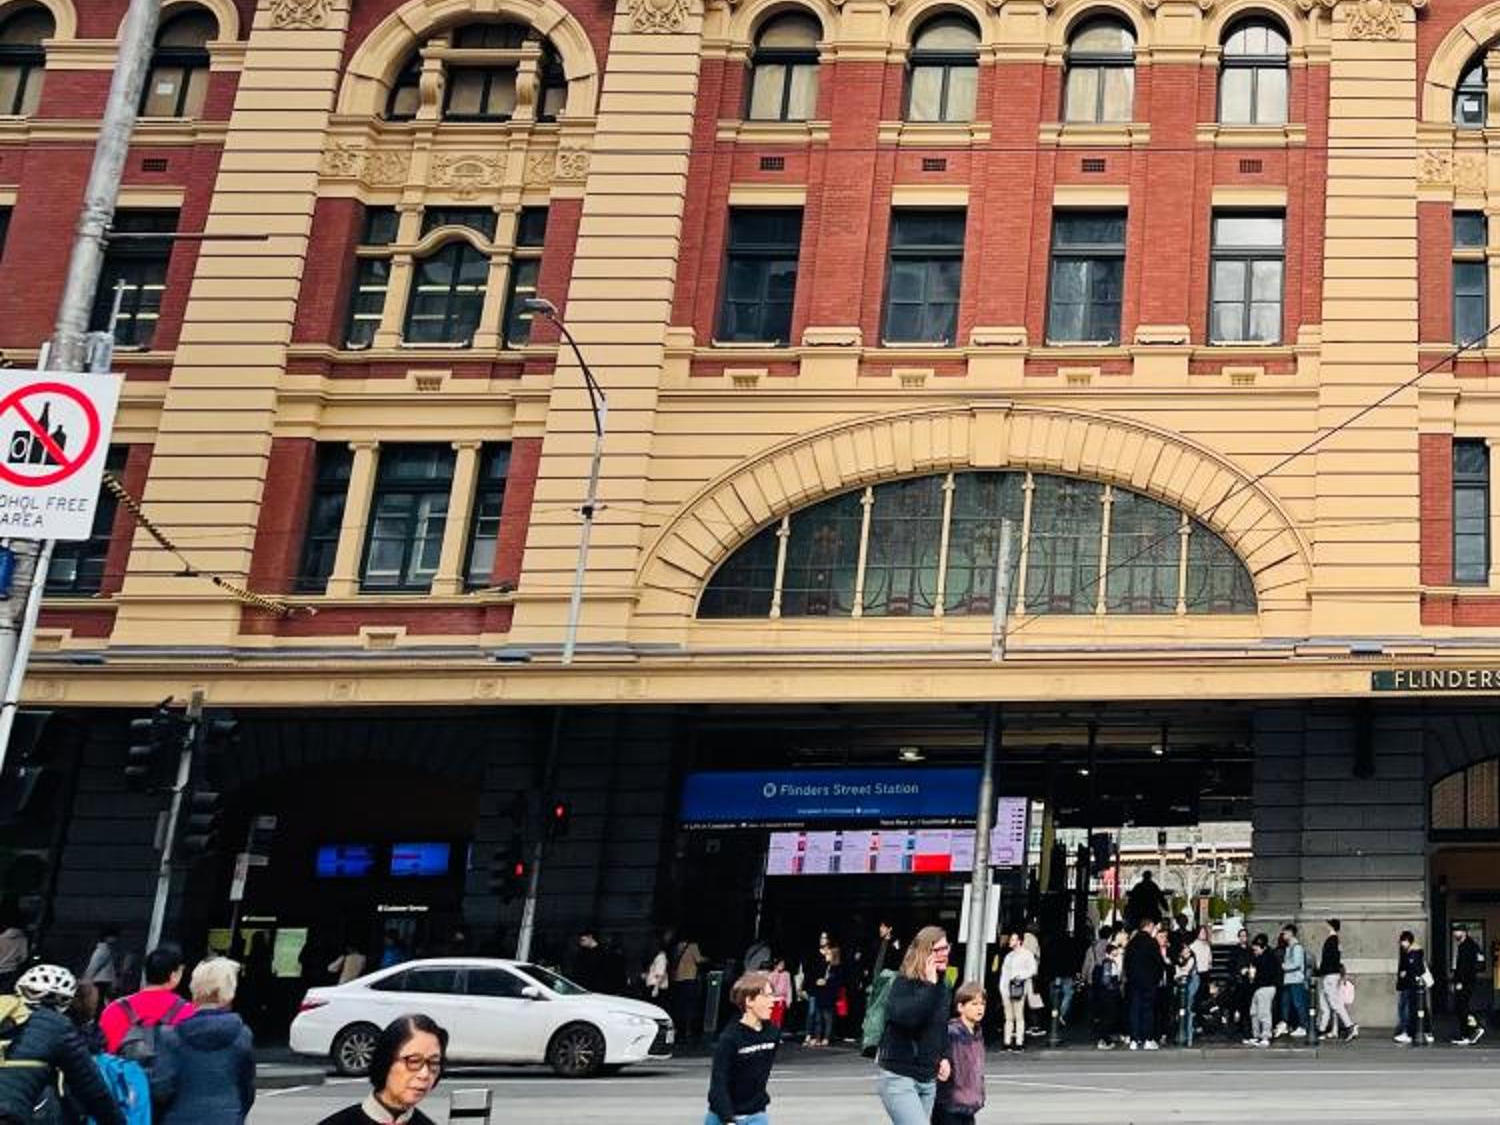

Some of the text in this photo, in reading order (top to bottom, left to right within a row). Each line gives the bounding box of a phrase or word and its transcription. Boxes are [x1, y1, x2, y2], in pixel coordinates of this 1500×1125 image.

[46, 496, 88, 511] FREE
[780, 782, 919, 796] Flinders Street Station
